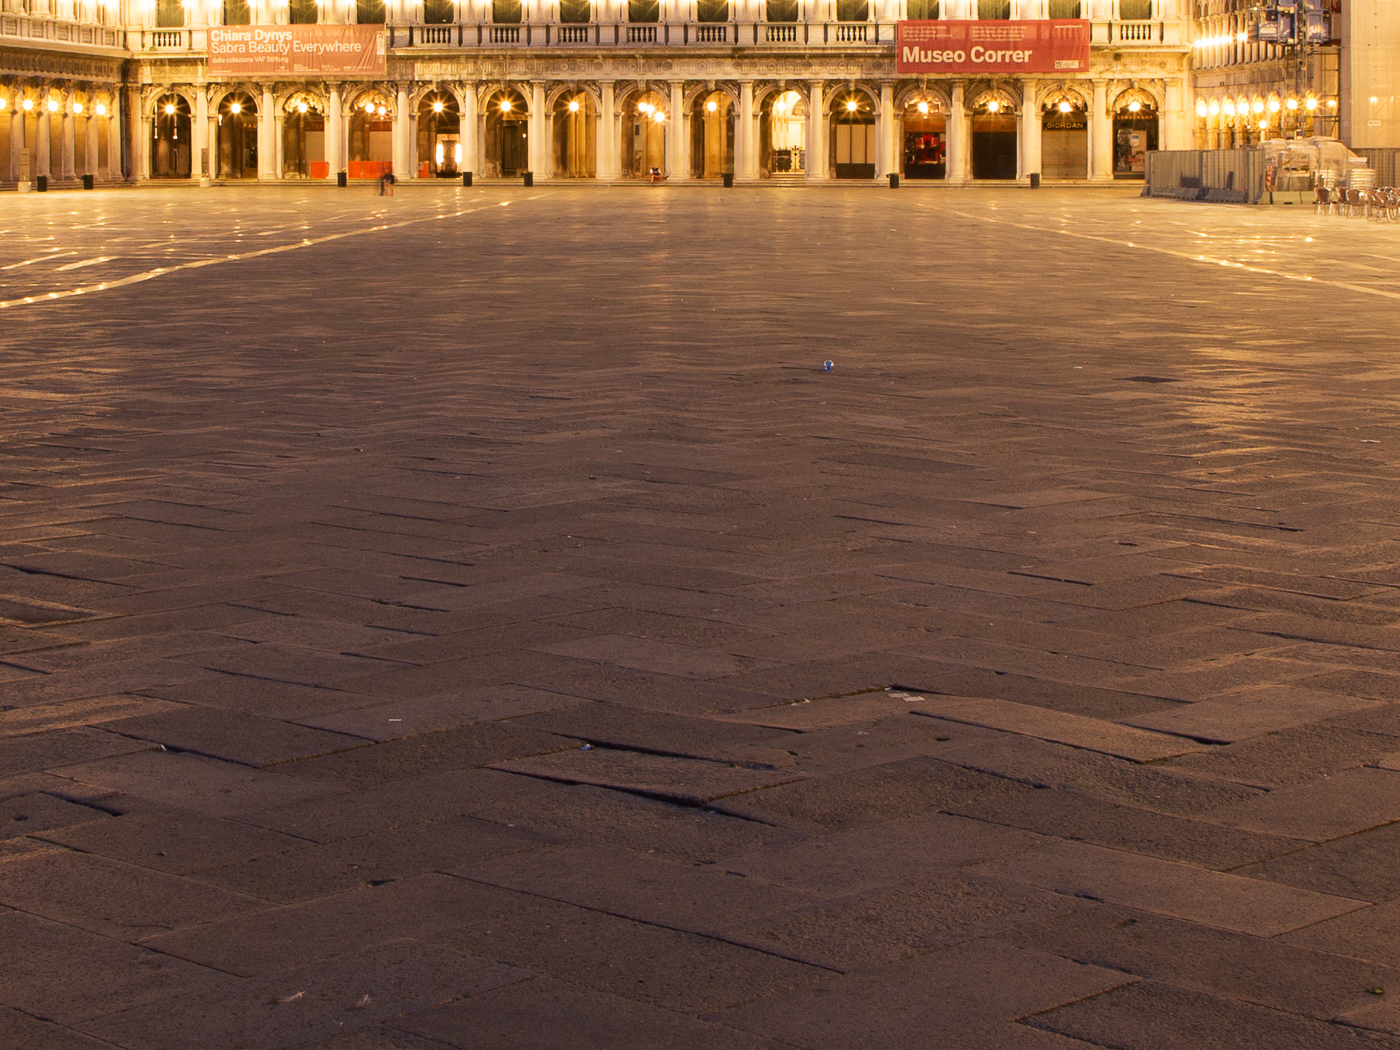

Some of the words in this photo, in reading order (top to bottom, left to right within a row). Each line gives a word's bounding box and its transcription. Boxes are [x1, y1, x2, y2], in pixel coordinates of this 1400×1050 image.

[211, 30, 251, 41] Chiara
[254, 29, 292, 43] Dynys
[211, 41, 246, 54] Sabra
[248, 41, 290, 55] Beauty
[293, 40, 362, 55] Everywhere
[902, 46, 966, 63] Museo
[970, 45, 1033, 63] Correr
